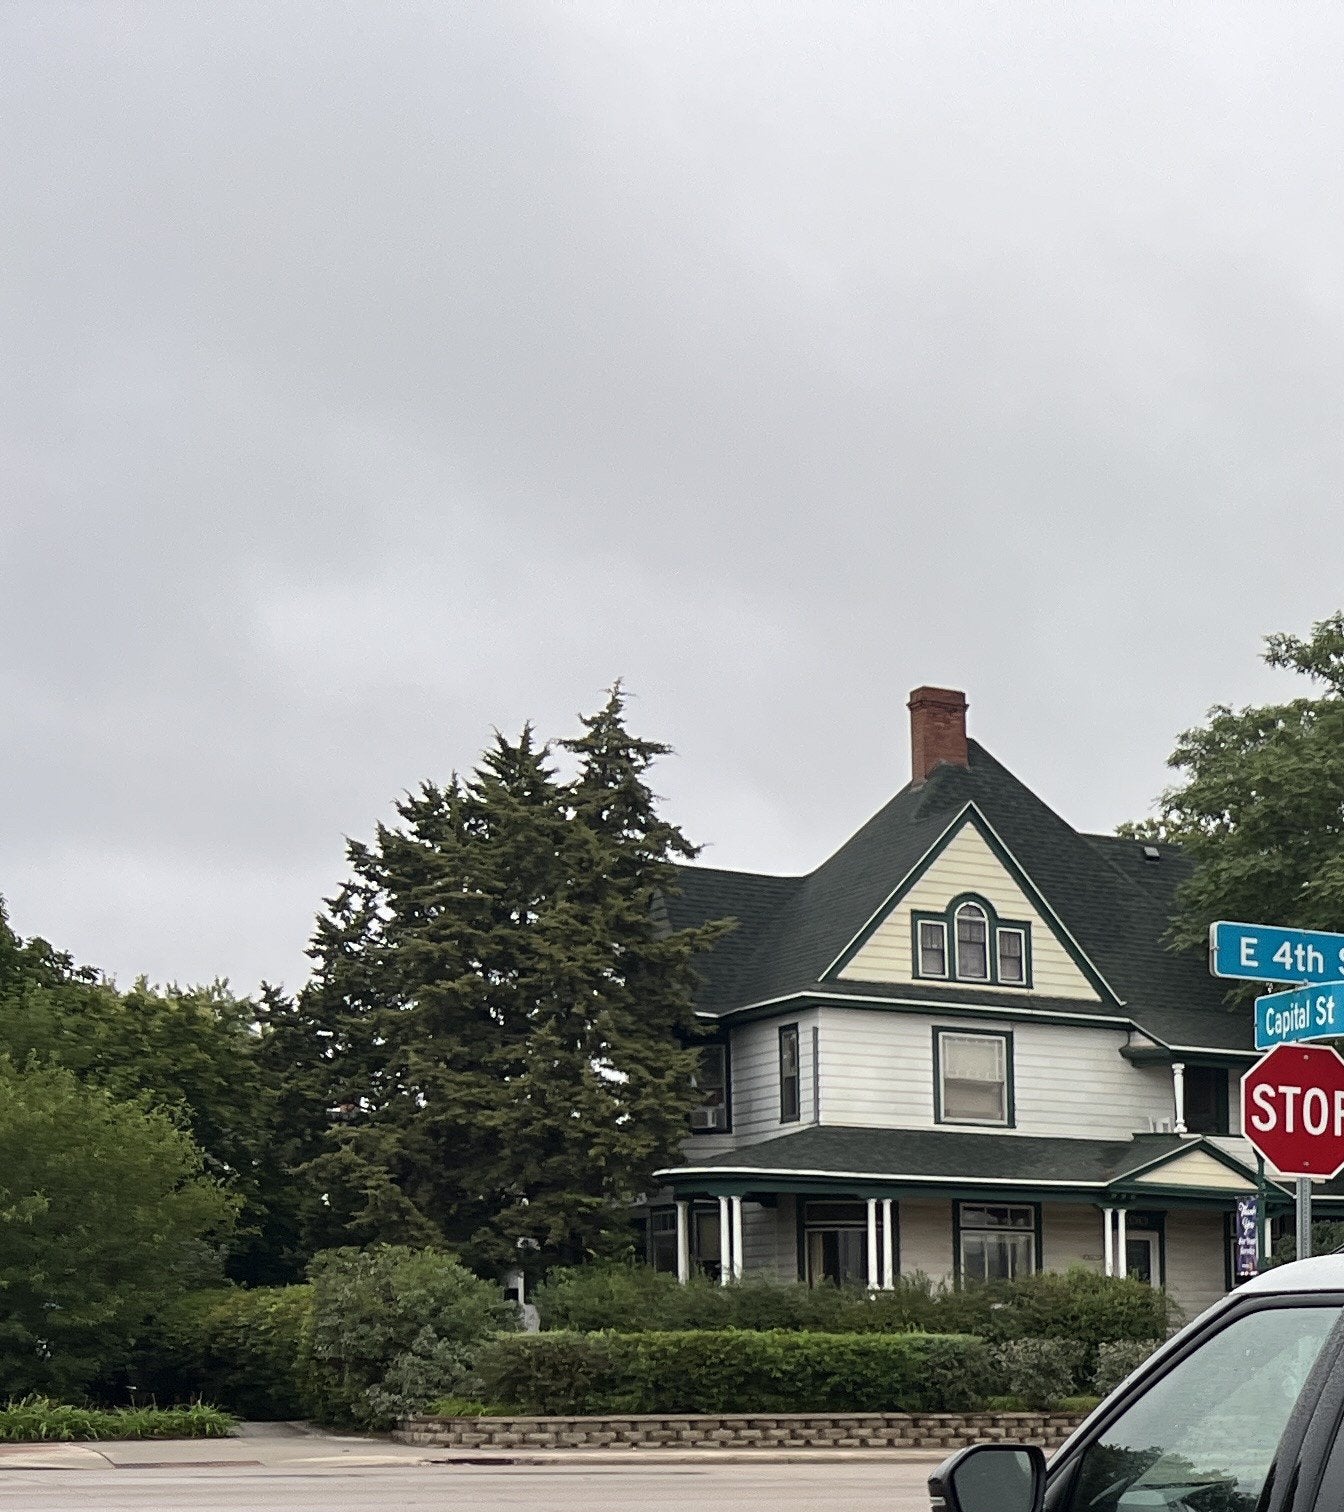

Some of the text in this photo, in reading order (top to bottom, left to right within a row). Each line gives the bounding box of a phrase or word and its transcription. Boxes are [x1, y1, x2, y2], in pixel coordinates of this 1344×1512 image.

[1240, 937, 1258, 967] E
[1272, 941, 1324, 974] 4th
[1265, 996, 1335, 1041] Capital St
